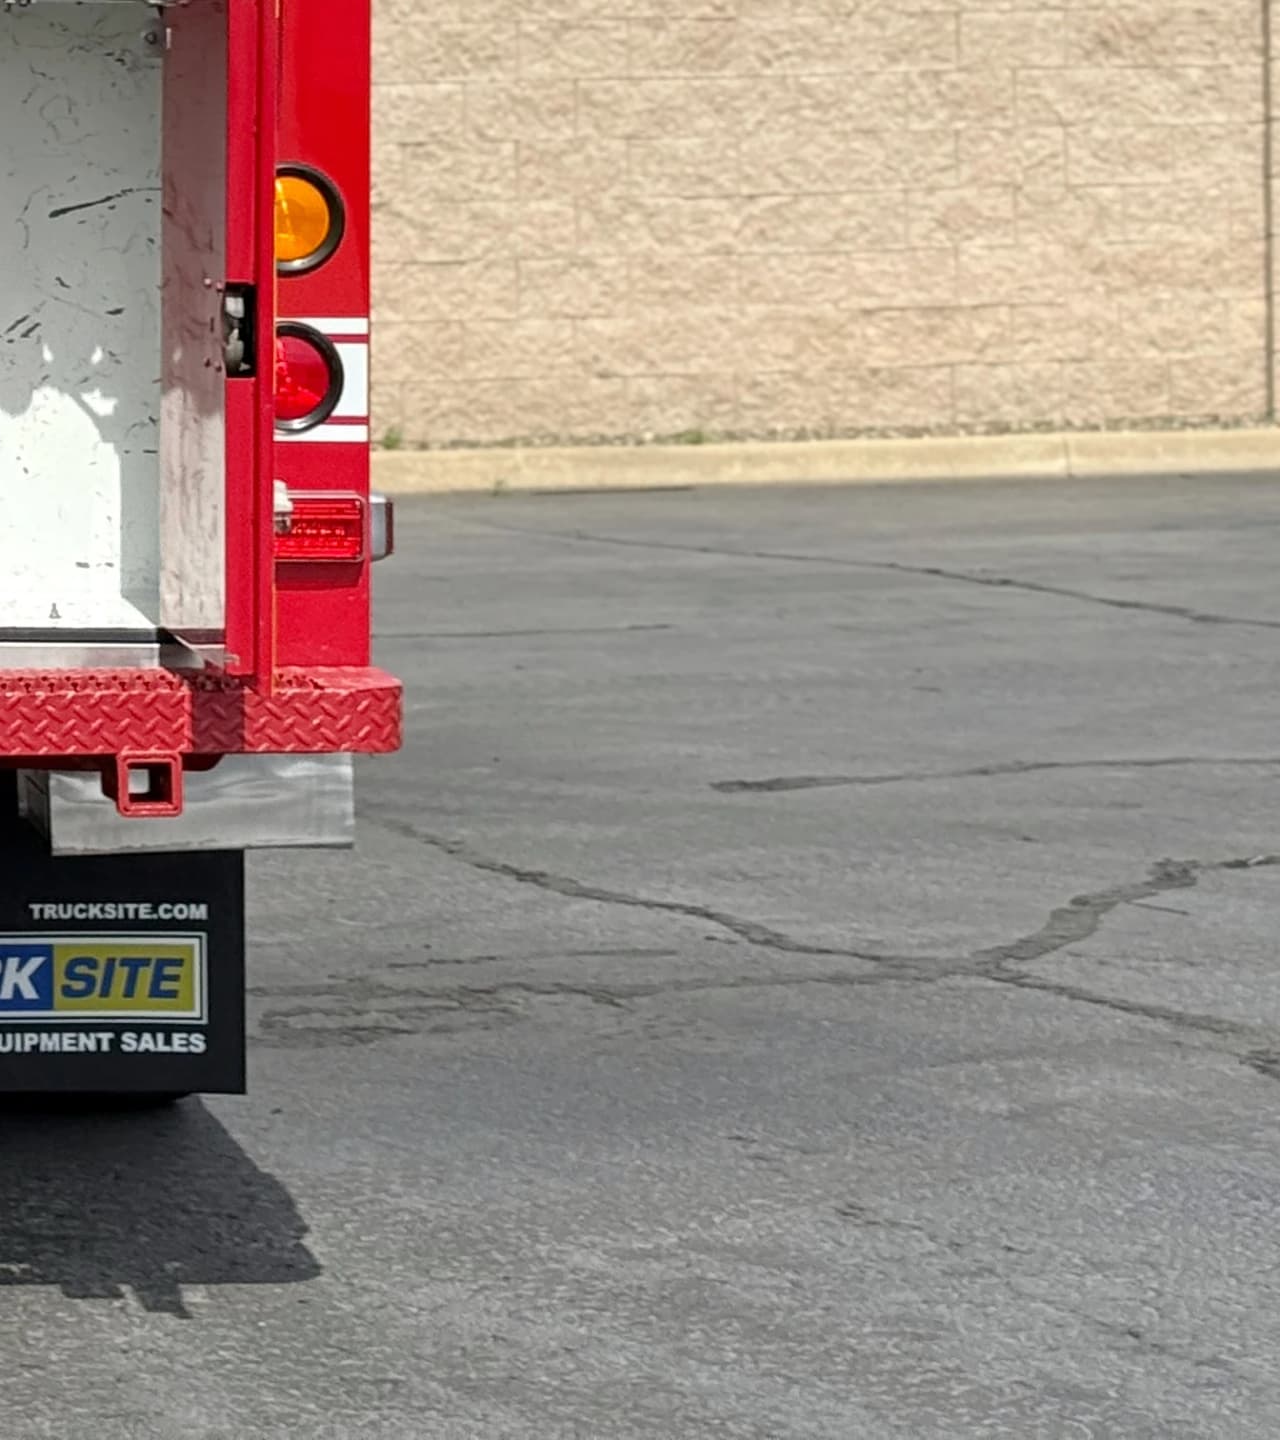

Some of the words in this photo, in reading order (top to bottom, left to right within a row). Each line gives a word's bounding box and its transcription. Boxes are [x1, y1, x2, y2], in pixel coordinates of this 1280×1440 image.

[29, 903, 208, 921] TRUCKSITE.COM
[60, 956, 184, 999] SITE
[120, 1032, 206, 1054] SALES
